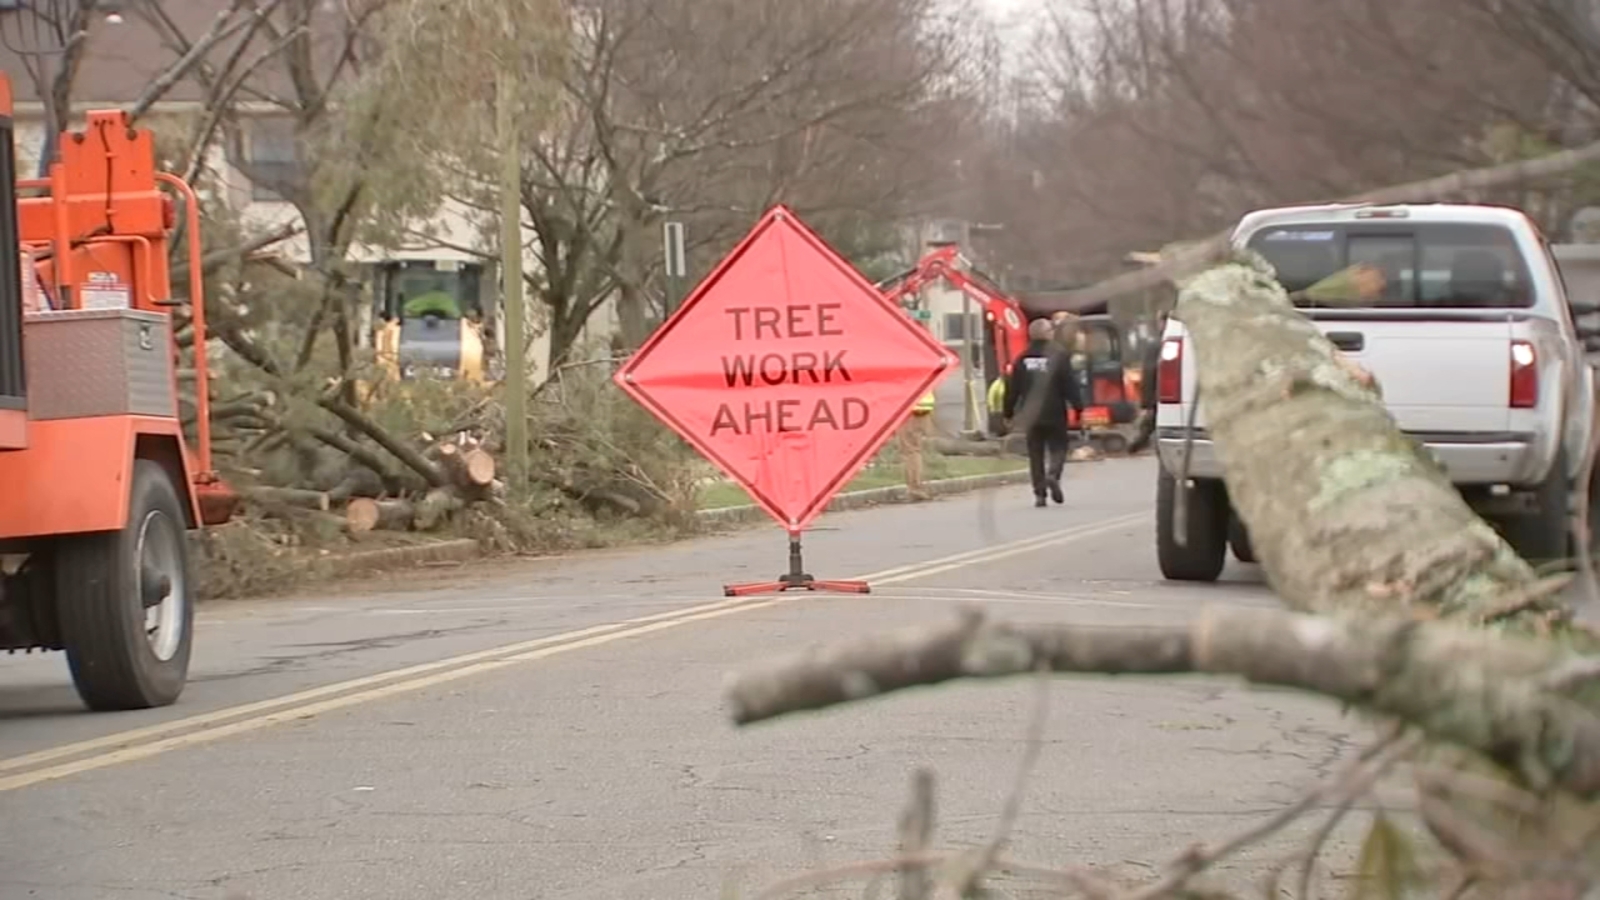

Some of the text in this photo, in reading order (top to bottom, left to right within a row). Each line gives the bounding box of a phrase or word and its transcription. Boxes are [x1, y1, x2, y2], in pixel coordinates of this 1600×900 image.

[724, 303, 844, 340] TREE
[721, 350, 852, 387] WORK
[709, 397, 870, 437] AHEAD
